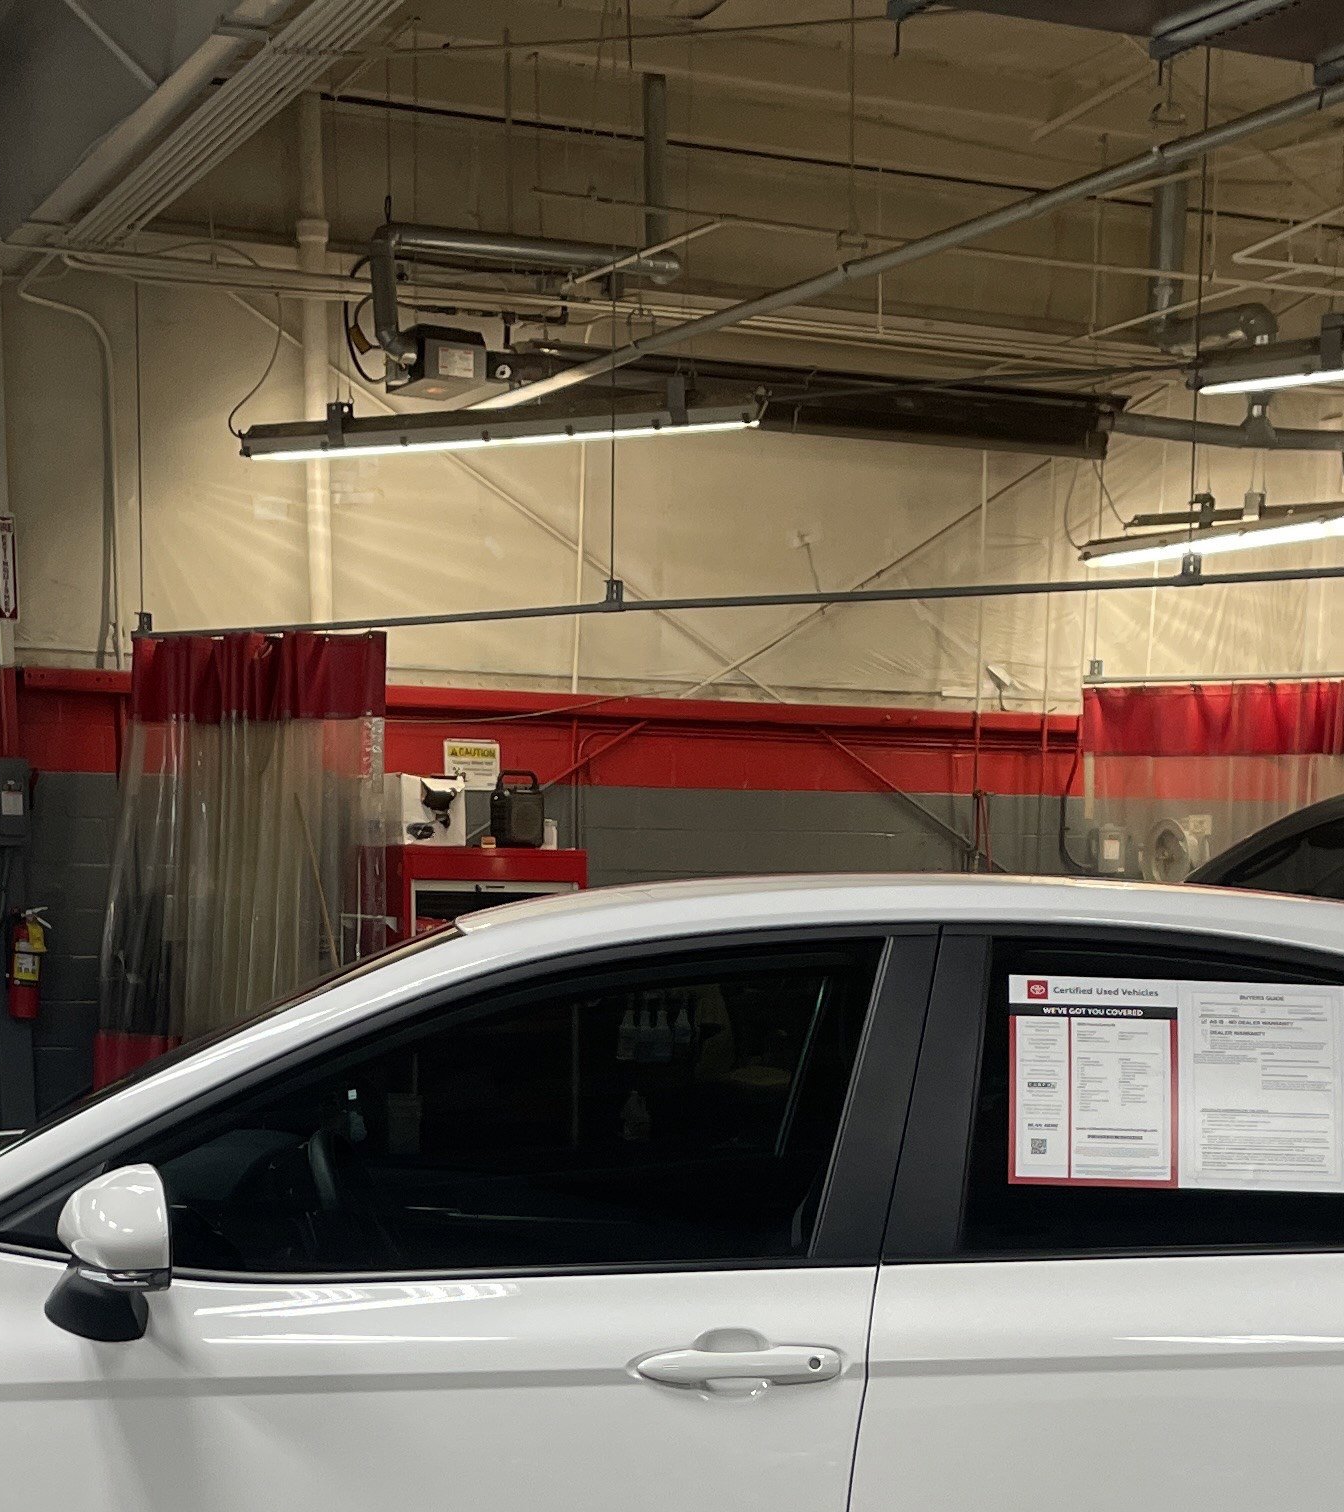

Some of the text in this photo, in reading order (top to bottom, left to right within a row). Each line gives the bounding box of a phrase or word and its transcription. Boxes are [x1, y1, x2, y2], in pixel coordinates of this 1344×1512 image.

[459, 748, 496, 758] CAUTION
[1053, 986, 1159, 997] Certified Used Vehicles
[1043, 1007, 1144, 1017] WE'VE GOT YOU COVERED
